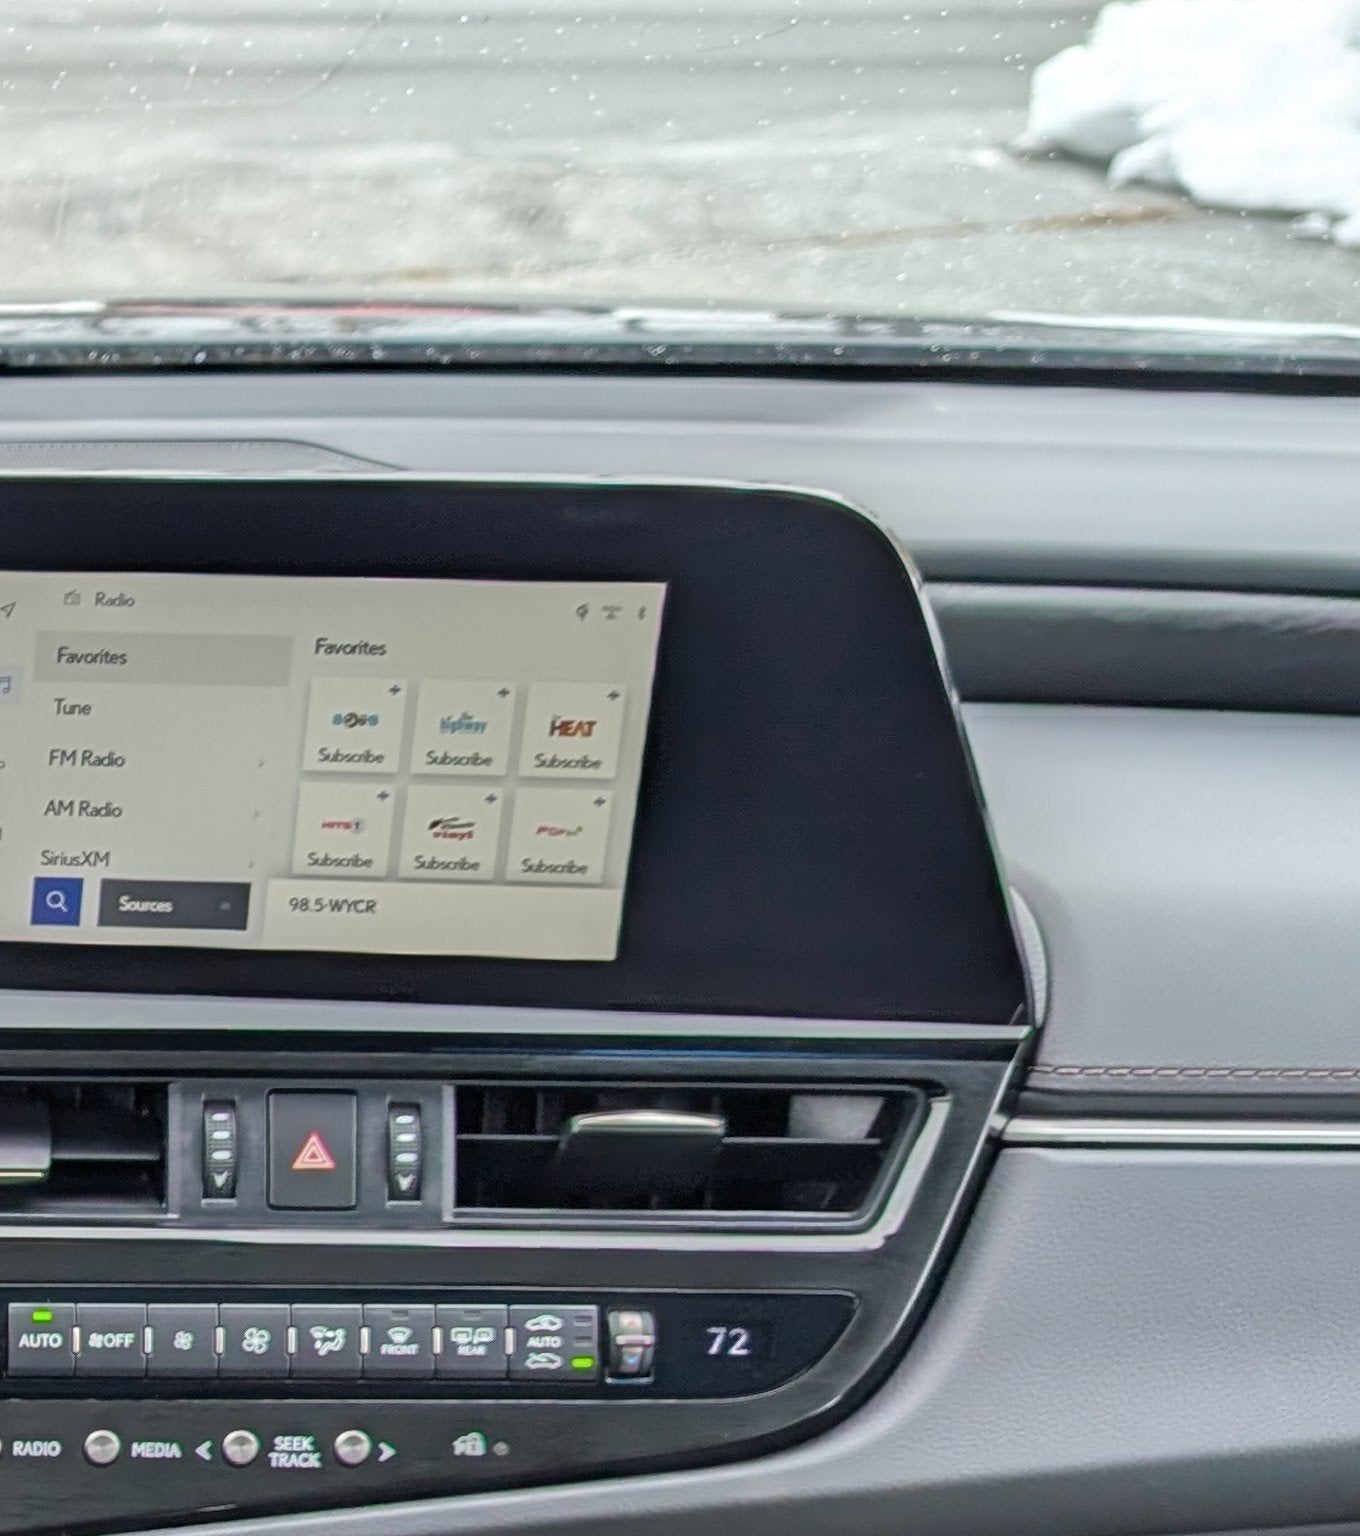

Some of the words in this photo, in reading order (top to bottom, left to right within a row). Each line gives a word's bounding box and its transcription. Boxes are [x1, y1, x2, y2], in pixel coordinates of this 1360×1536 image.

[95, 591, 135, 607] Radio
[314, 637, 387, 656] Favorites
[56, 646, 127, 665] Favorites
[54, 698, 91, 715] Tune
[48, 749, 77, 766] FM
[81, 750, 125, 767] Radio
[318, 747, 384, 763] Subscribe
[425, 750, 493, 766] Subscribe
[534, 753, 602, 769] Subscribe
[44, 800, 74, 816] AM
[79, 801, 123, 817] Radio
[40, 850, 112, 867] SiriusXM
[307, 852, 374, 868] Subscribe
[414, 855, 480, 871] Subscribe
[521, 858, 589, 874] Subscribe
[118, 895, 174, 913] Sources
[19, 1332, 63, 1348] AUTO
[104, 1333, 135, 1348] OFF
[526, 1336, 562, 1349] AUTO
[706, 1326, 751, 1355] 72
[380, 1344, 420, 1355] FRONT
[457, 1344, 487, 1356] REAR
[12, 1440, 62, 1457] RADIO
[131, 1441, 182, 1459] MEDIA
[273, 1435, 315, 1451] SEEK
[268, 1452, 322, 1468] TRACK
